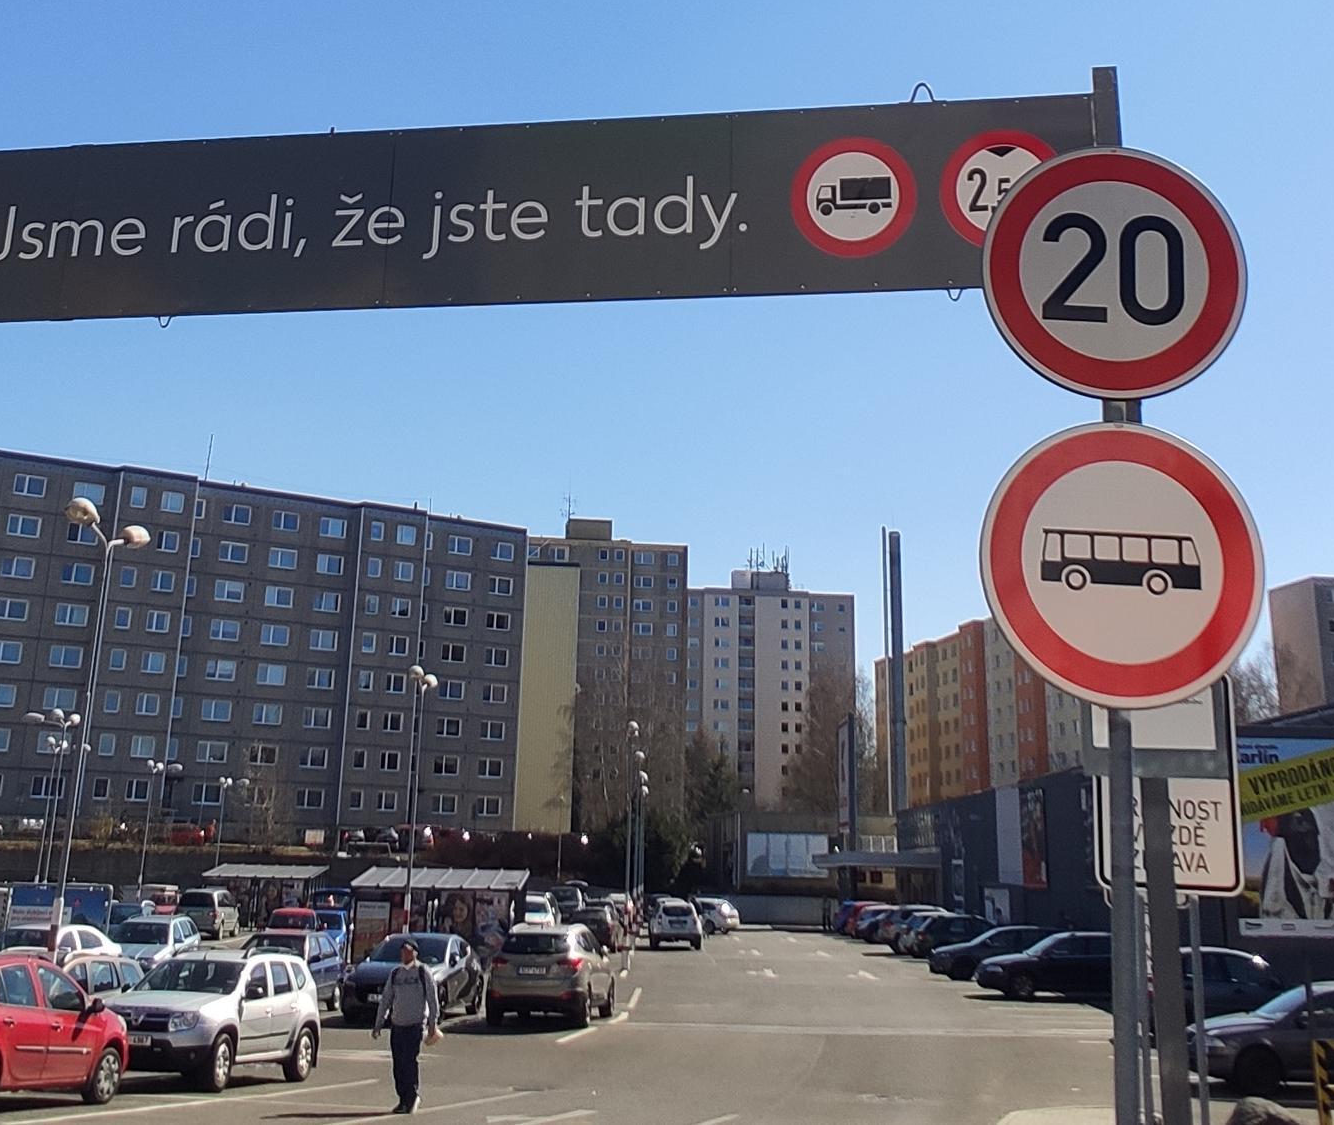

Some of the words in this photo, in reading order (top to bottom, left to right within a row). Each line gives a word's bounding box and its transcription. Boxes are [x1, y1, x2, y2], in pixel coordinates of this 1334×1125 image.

[170, 193, 309, 258] rádi,
[331, 193, 405, 247] že
[422, 189, 550, 260] jste
[574, 175, 748, 250] tady.
[1041, 212, 1185, 326] 20
[1168, 798, 1222, 821] NOST
[1173, 852, 1210, 874] AVA
